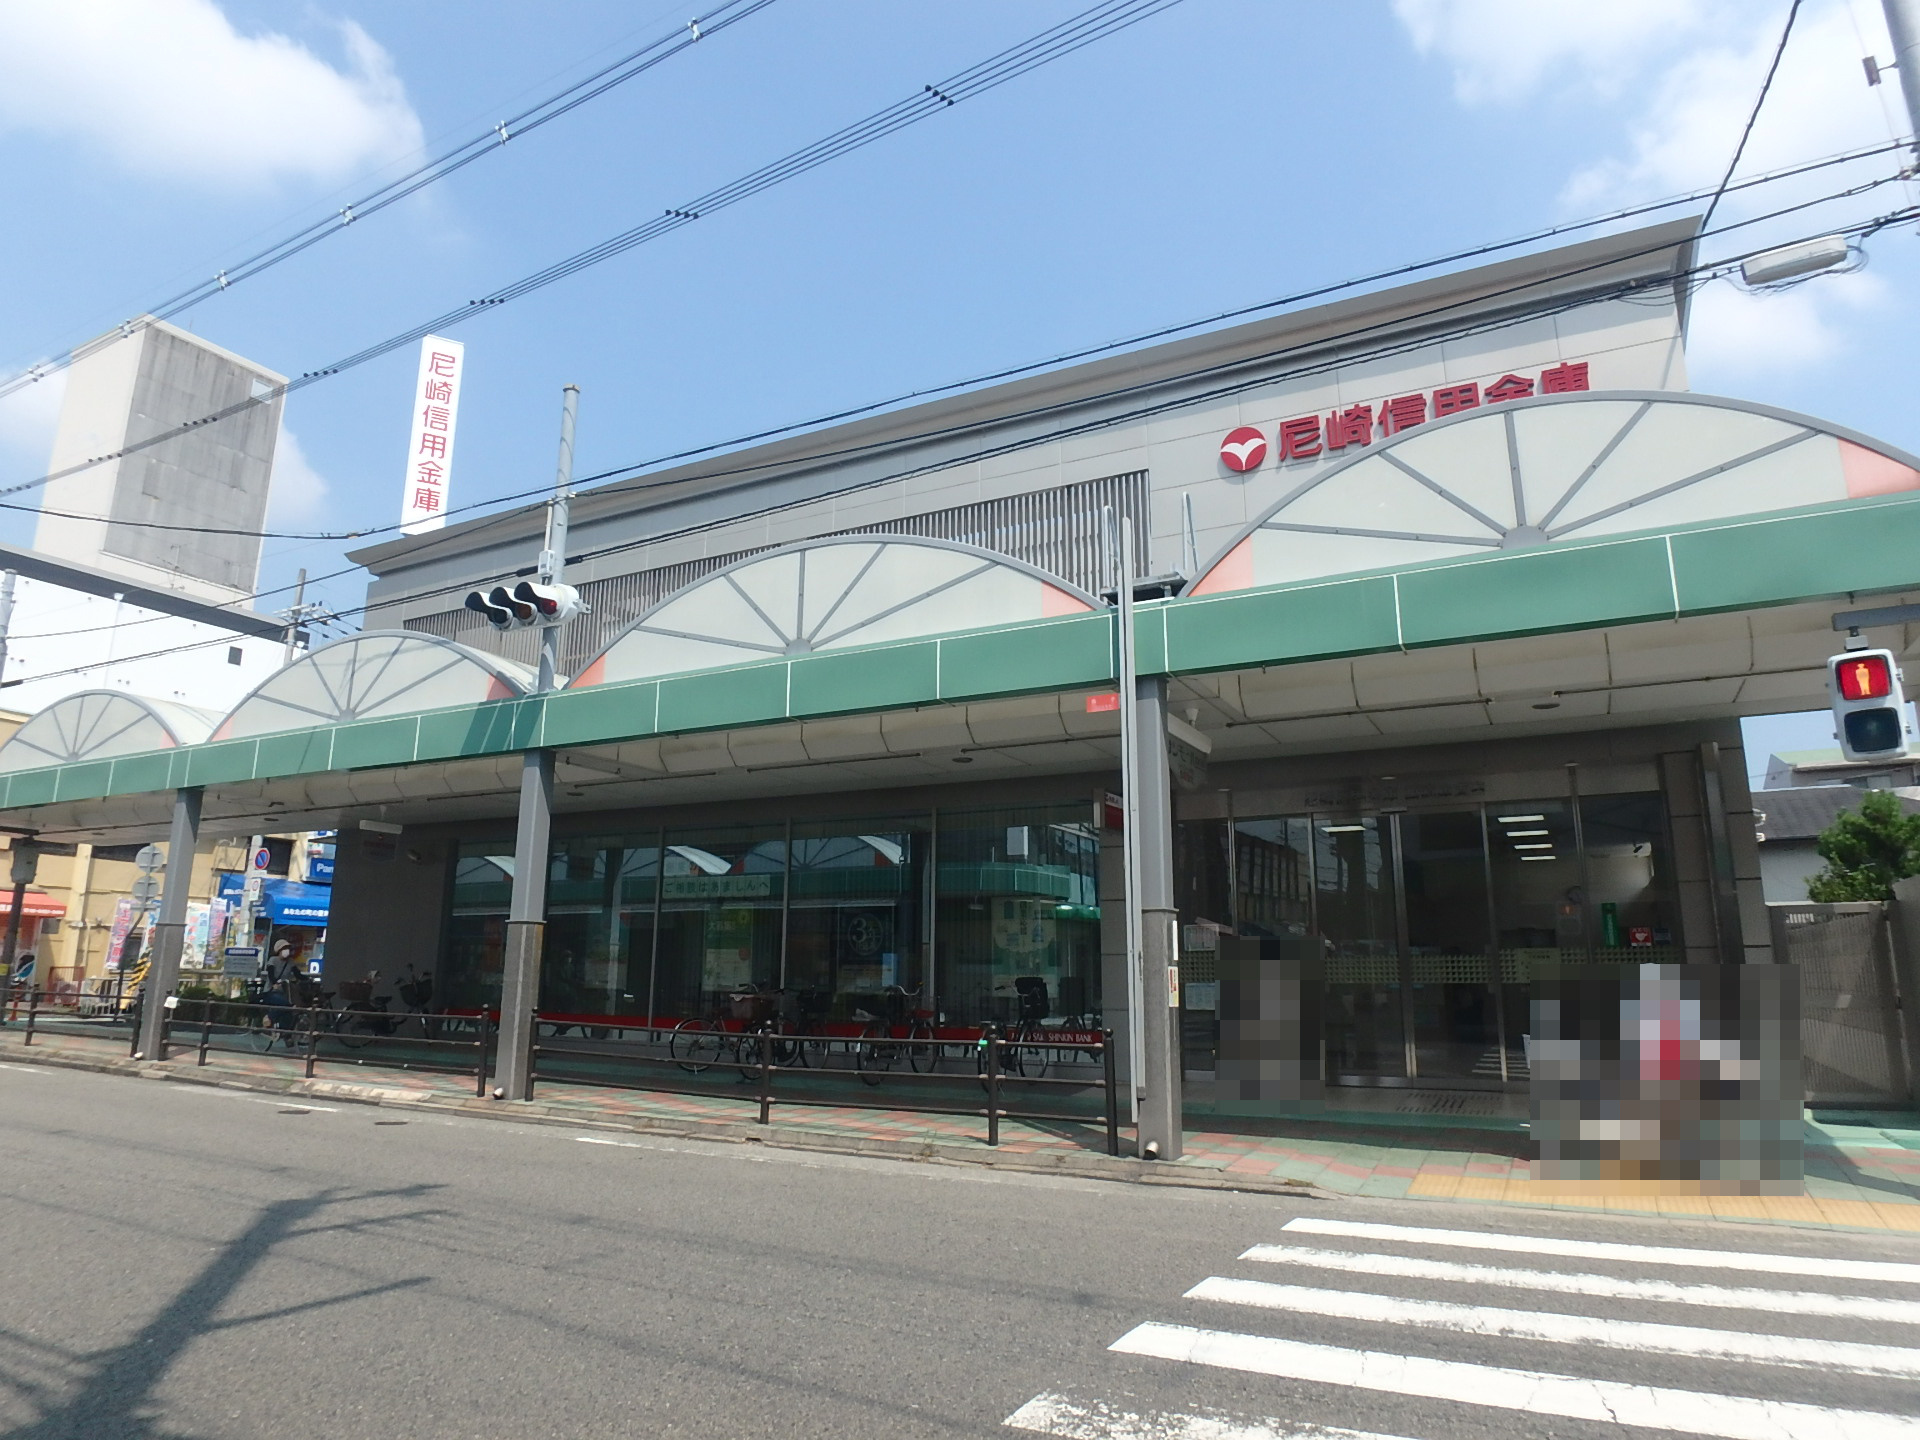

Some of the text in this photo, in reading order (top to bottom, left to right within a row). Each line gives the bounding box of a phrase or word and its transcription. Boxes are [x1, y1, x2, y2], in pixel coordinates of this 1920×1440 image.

[413, 352, 456, 513] 尼崎信用金庫
[1279, 362, 1590, 461] 尼崎信用金庫
[664, 881, 769, 894] ご相談はあましんへ
[1075, 1033, 1093, 1043] BANK
